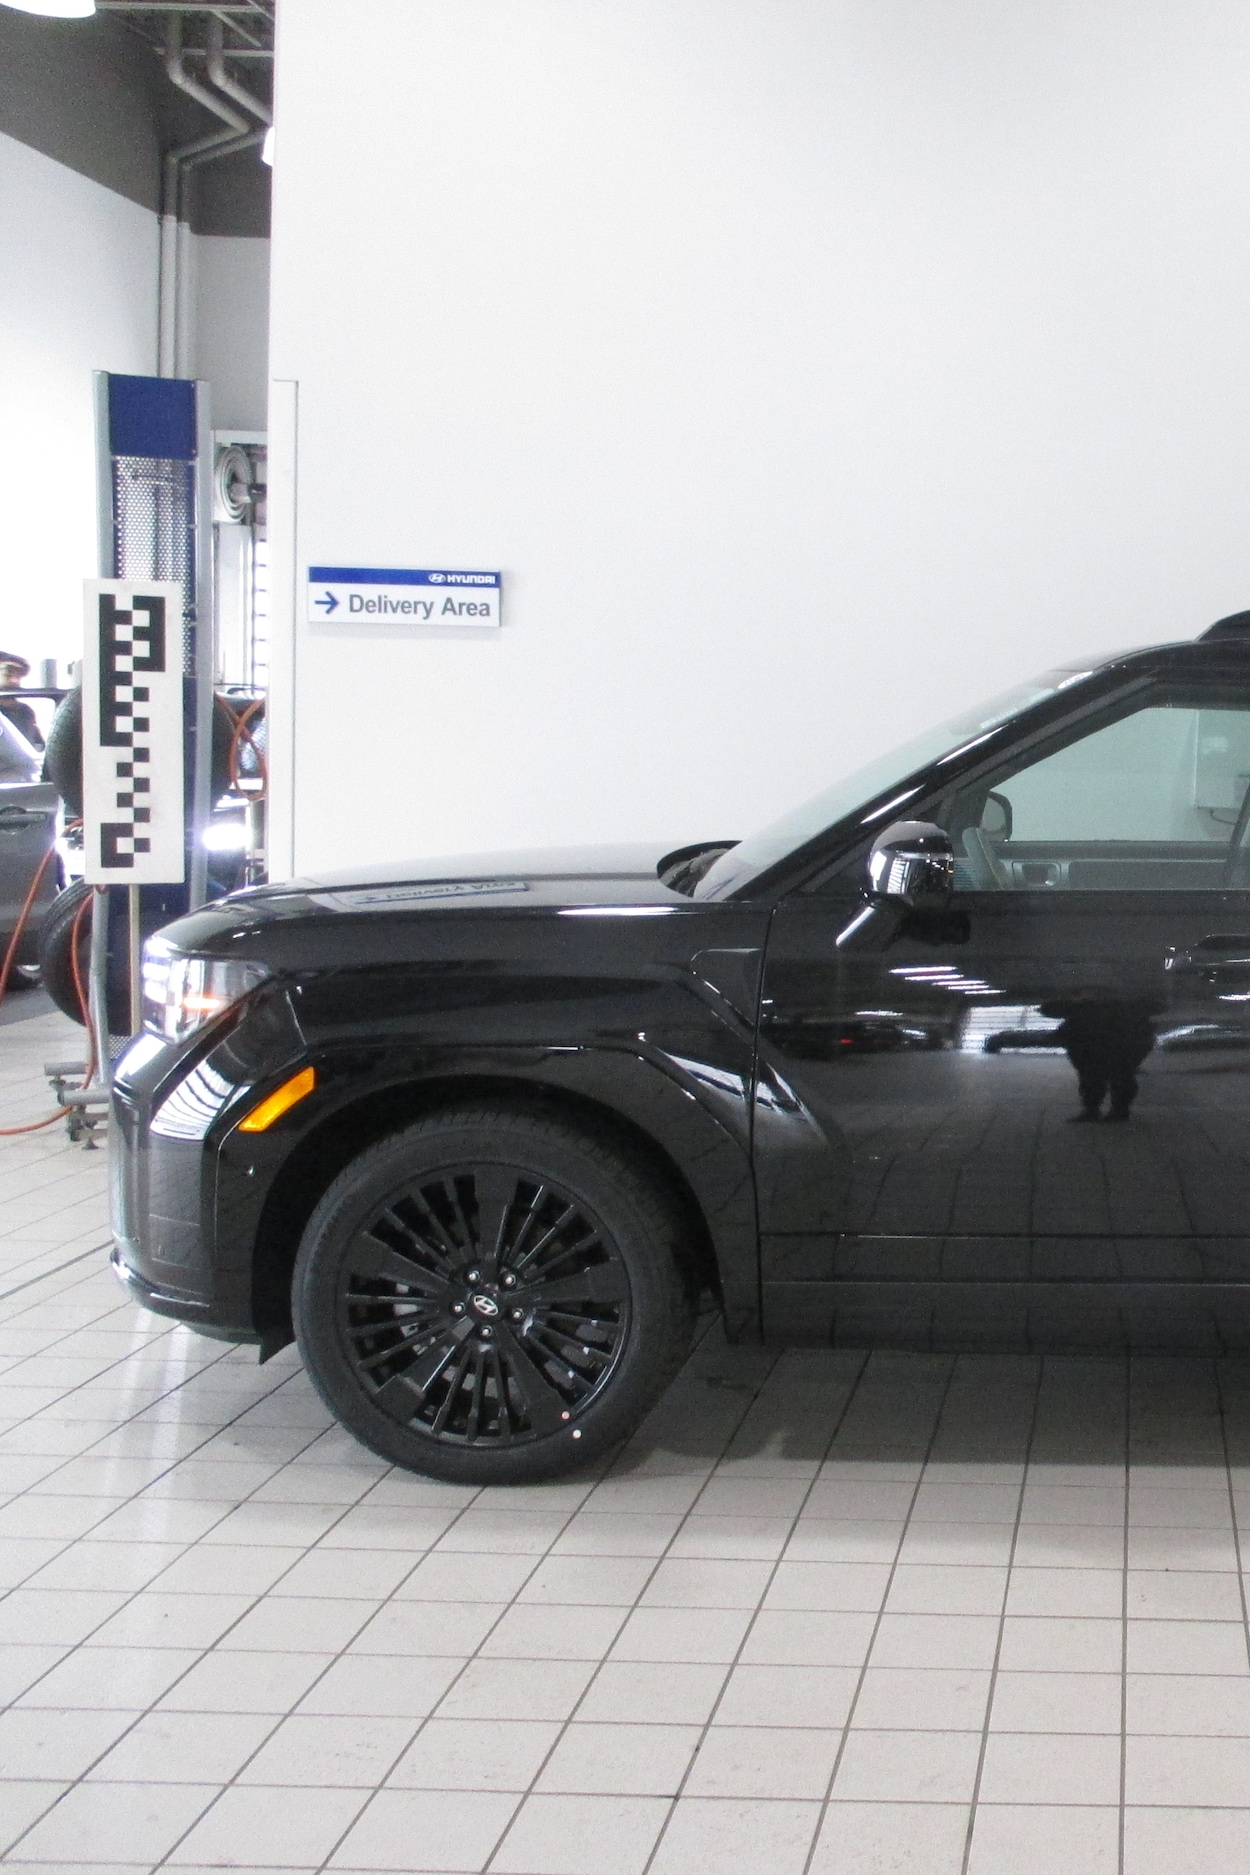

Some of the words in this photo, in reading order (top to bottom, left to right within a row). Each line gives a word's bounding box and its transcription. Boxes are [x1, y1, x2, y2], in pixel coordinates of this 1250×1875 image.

[447, 575, 496, 584] HYUNDAI
[349, 594, 434, 620] Delivery
[441, 597, 491, 617] Area
